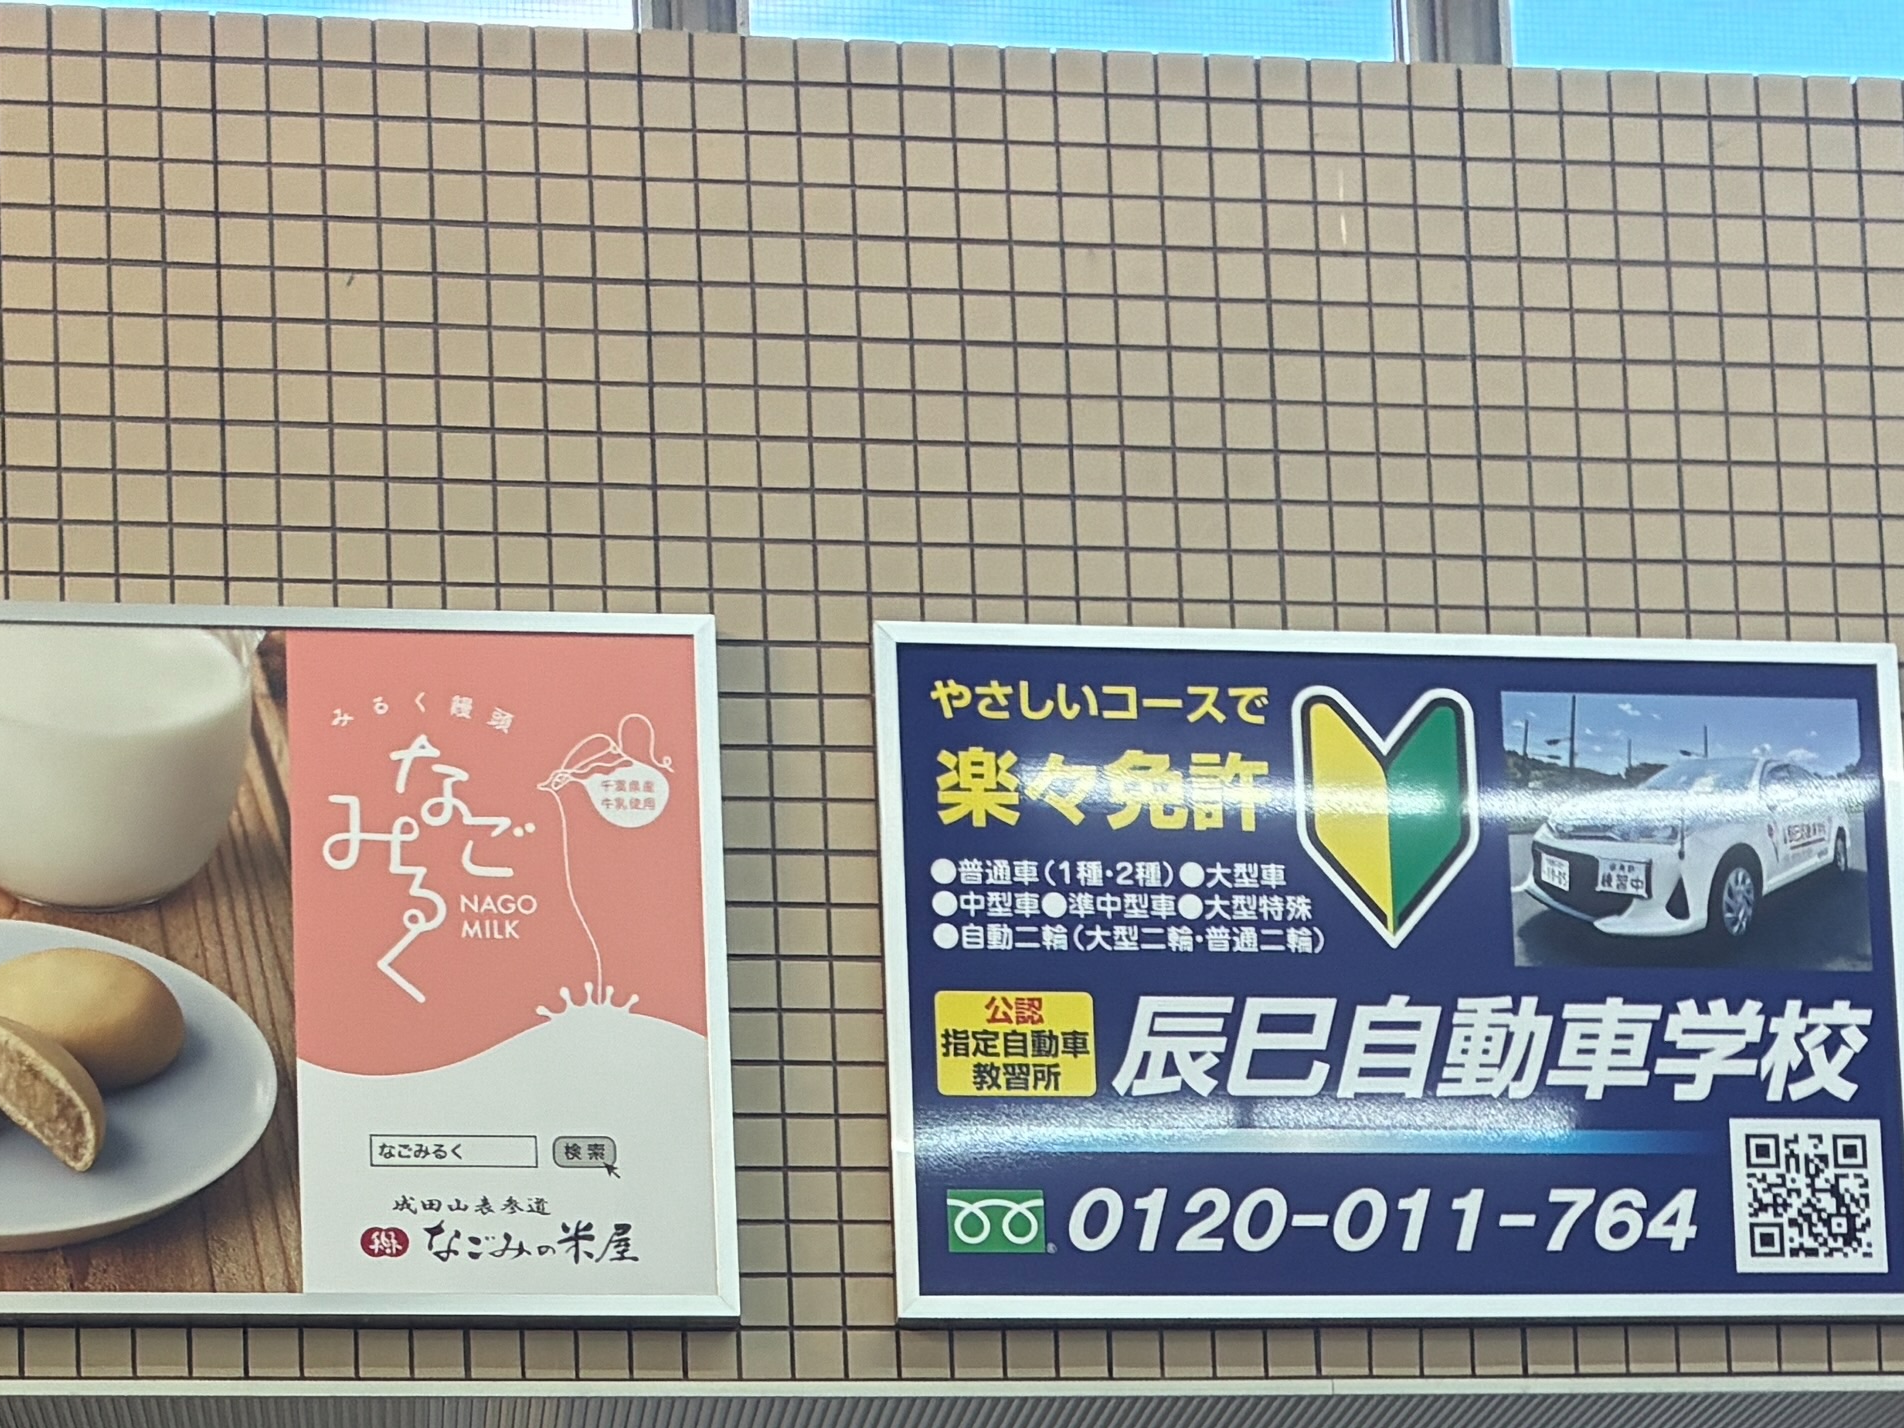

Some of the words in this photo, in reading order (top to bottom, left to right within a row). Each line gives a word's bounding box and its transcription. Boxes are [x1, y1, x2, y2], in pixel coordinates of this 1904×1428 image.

[930, 679, 1270, 726] やさしいコースで
[935, 745, 1271, 833] 楽々免許
[459, 894, 538, 915] NAGO
[460, 920, 521, 939] MILK
[984, 996, 1044, 1025] 公認
[940, 1029, 1091, 1061] 指定自動車
[1112, 992, 1874, 1101] 辰巳自動車学校
[970, 1060, 1063, 1093] 教習所
[378, 1143, 463, 1160] なごみるく
[563, 1142, 606, 1161] 検索
[392, 1195, 552, 1216] 成田山表参道
[1066, 1188, 1698, 1254] 0120-011-764
[422, 1218, 640, 1265] なごみの米屋
